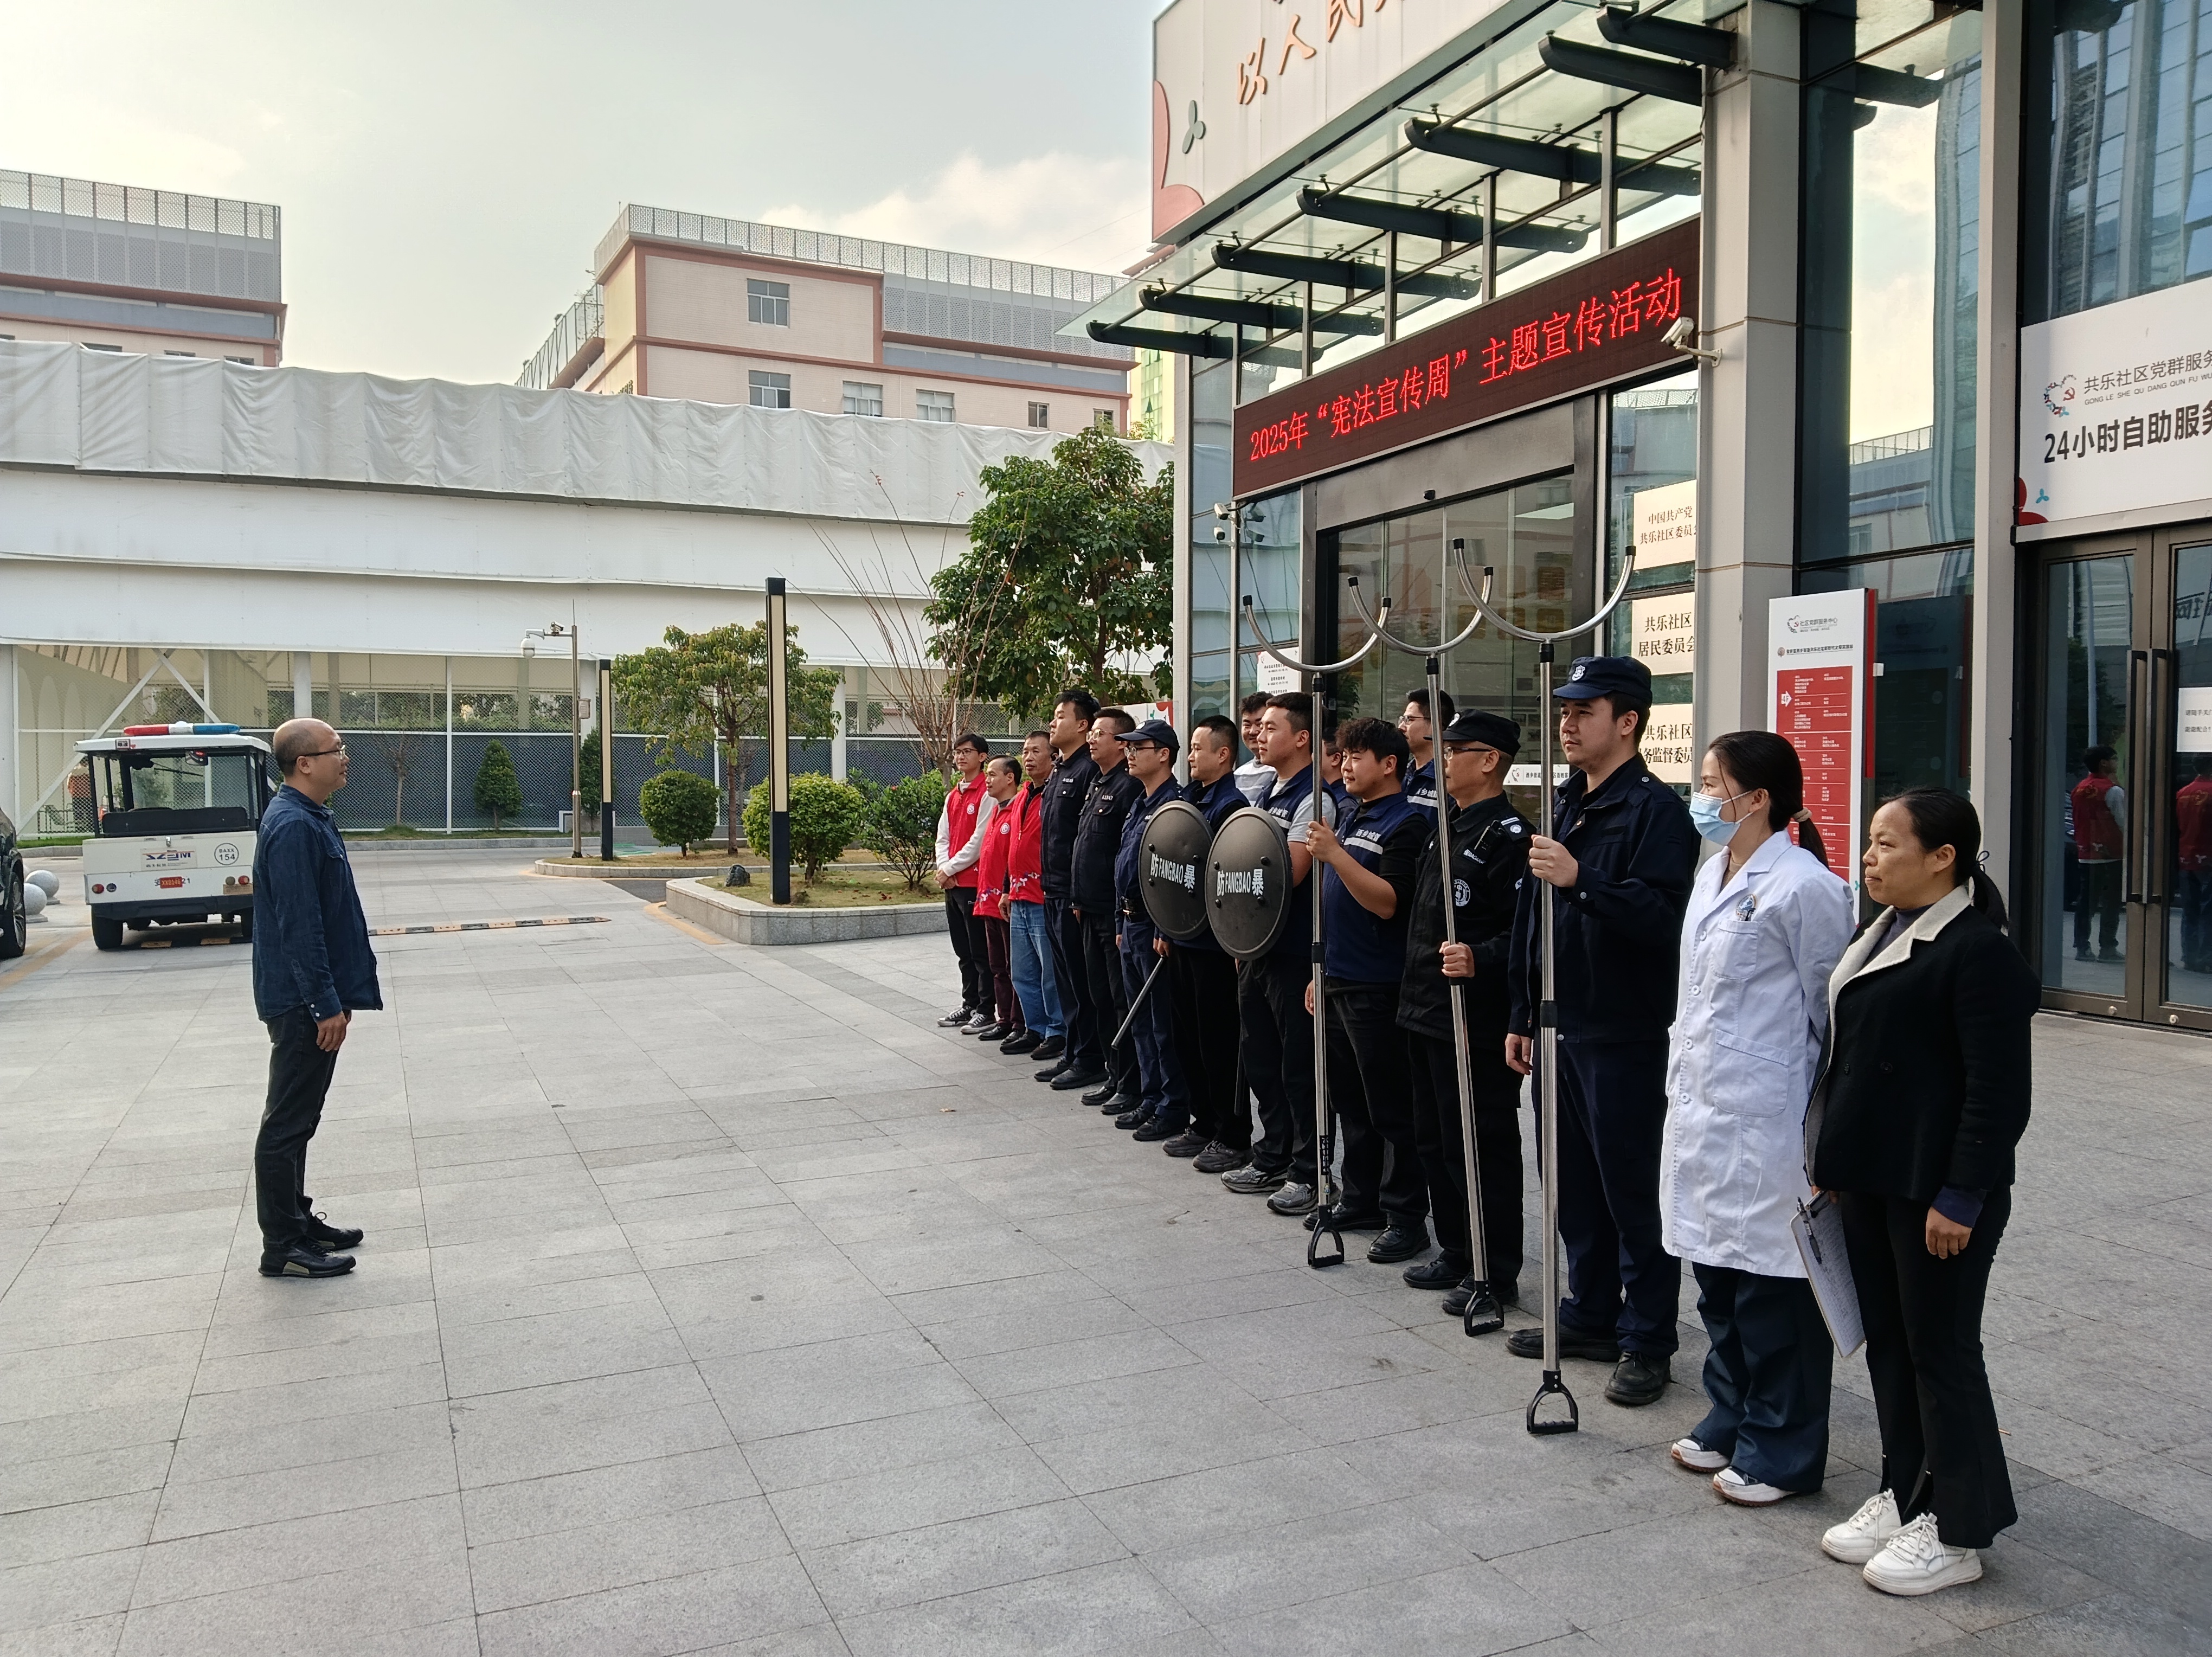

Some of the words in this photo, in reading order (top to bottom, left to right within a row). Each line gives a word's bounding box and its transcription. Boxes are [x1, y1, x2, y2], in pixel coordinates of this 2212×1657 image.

[1236, 0, 1386, 105] 以人民
[2085, 395, 2104, 406] GONG
[2106, 393, 2114, 402] LE
[2117, 390, 2131, 399] SHE
[2147, 382, 2167, 392] DANG
[2170, 378, 2185, 387] QUN
[1648, 505, 1693, 525] 中国共产党
[1644, 612, 1692, 633] 共乐社区
[1638, 635, 1695, 657] 居民委员会
[1644, 723, 1693, 741] 共乐社区
[1638, 746, 1693, 765] 务监督委员
[218, 853, 235, 861] 154
